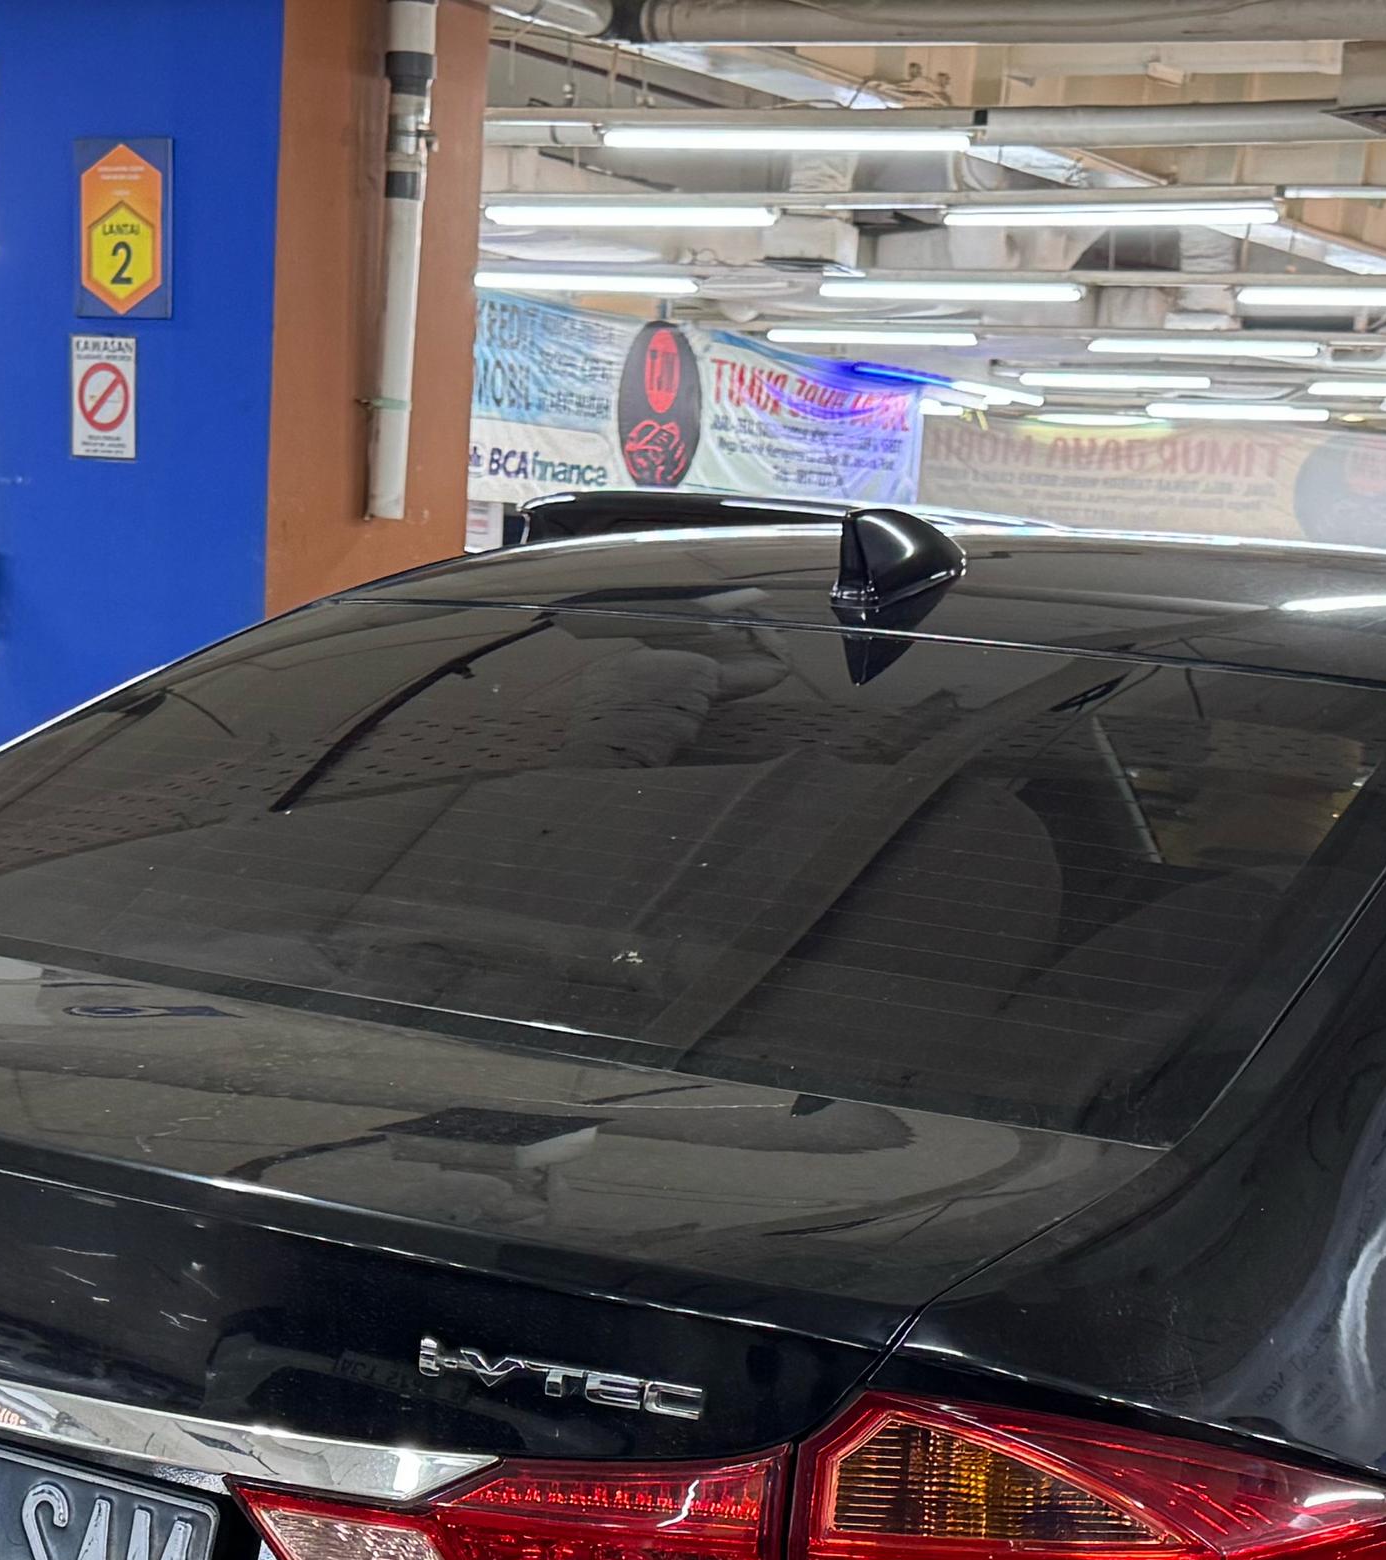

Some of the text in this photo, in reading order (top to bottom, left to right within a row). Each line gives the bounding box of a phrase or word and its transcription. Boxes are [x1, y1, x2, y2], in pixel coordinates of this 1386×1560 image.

[102, 223, 140, 236] LANTAI
[111, 241, 133, 285] 2
[488, 447, 530, 480] BCA
